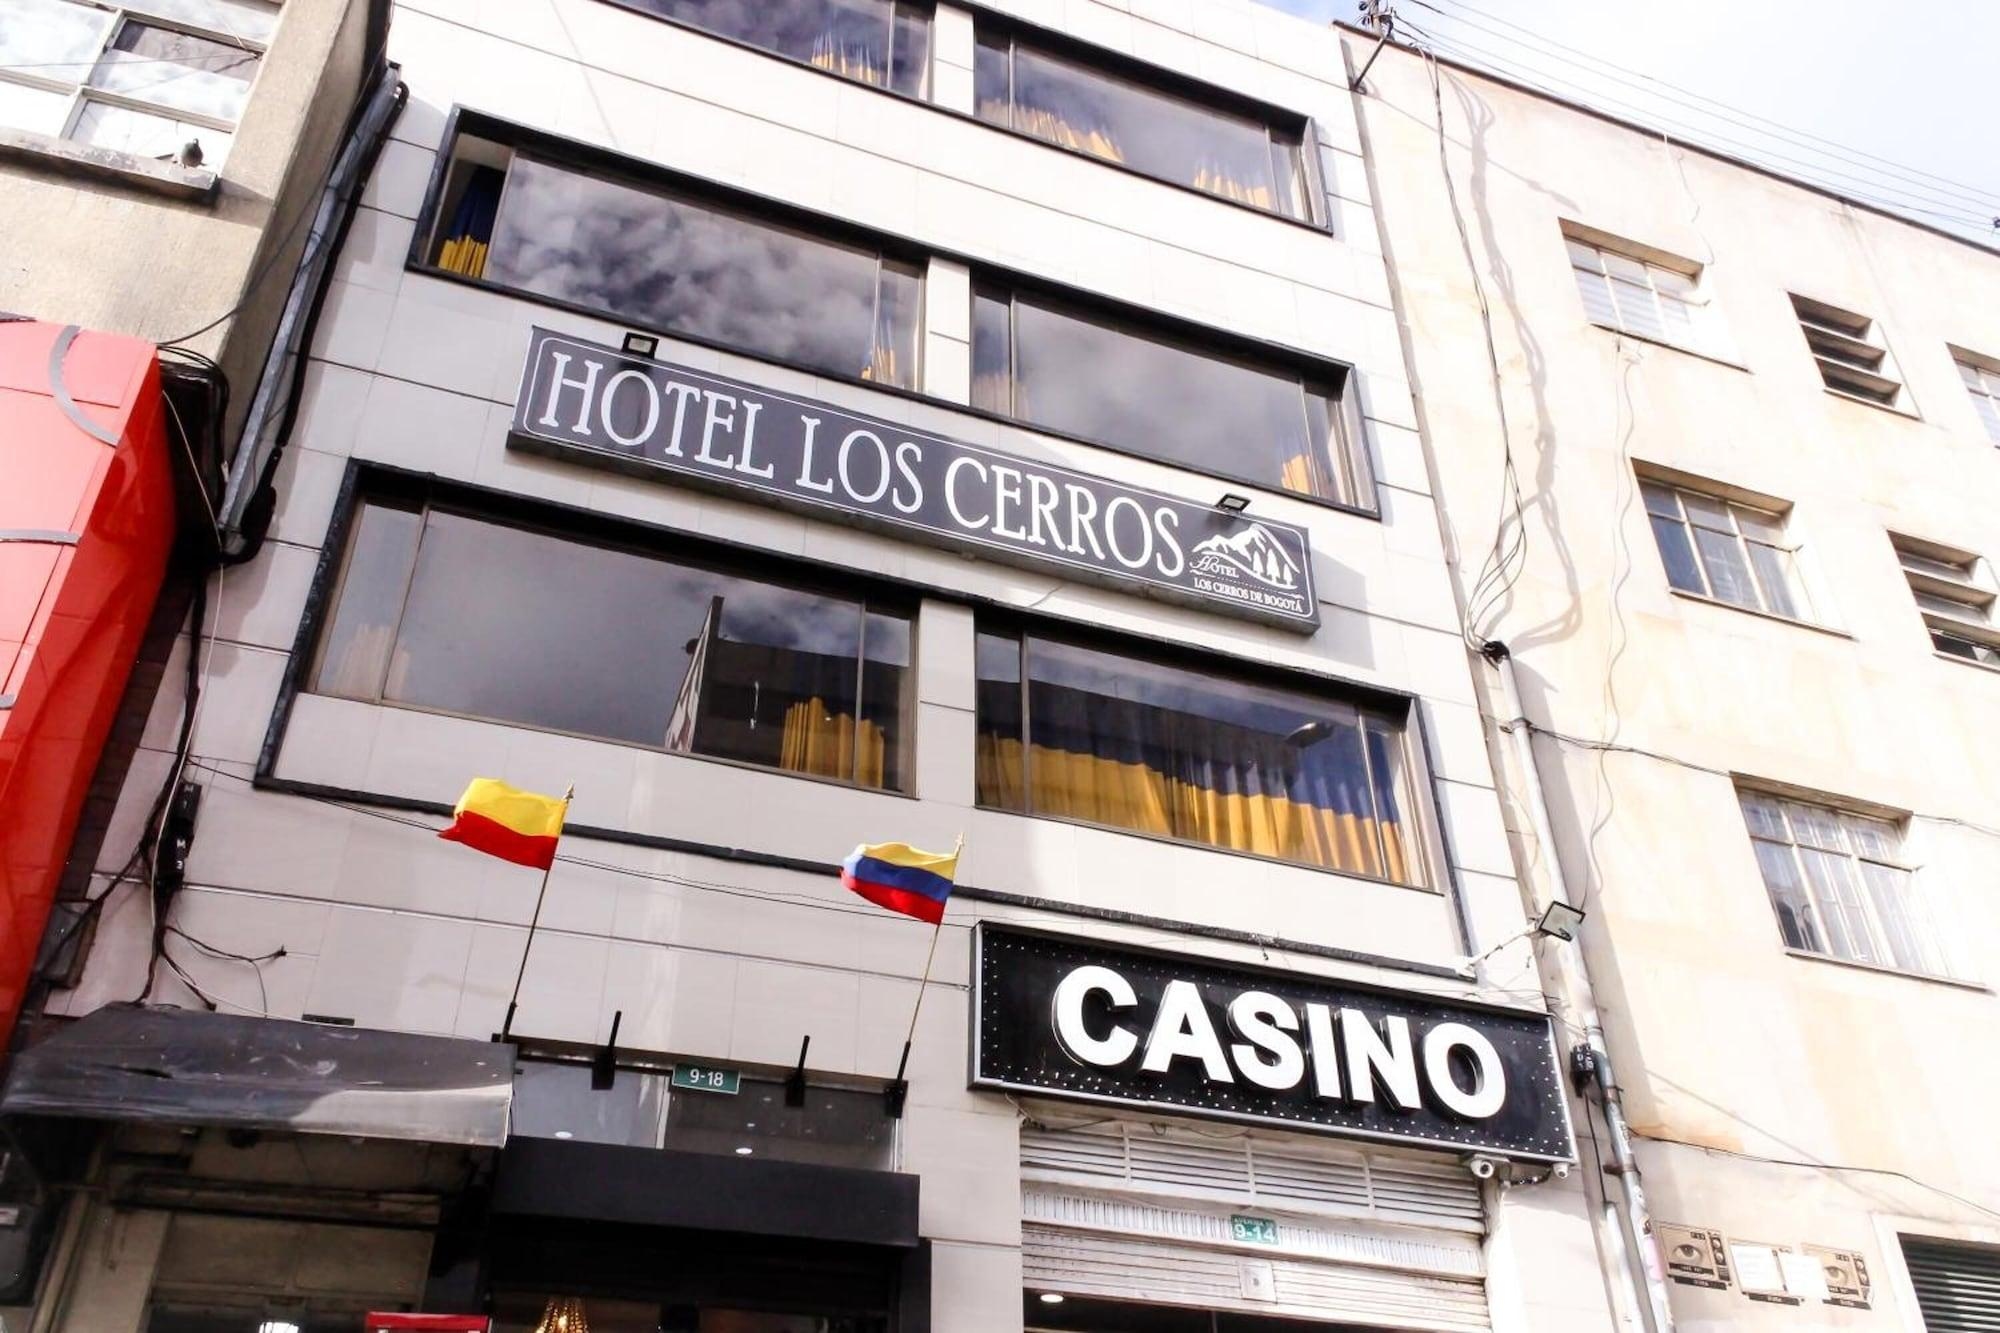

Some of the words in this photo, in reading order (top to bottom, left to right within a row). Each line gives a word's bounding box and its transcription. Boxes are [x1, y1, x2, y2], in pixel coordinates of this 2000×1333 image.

[539, 351, 775, 480] HOTEL
[796, 415, 923, 514] LOS
[945, 456, 1185, 577] CERROS
[1189, 556, 1240, 577] HOTEL
[1193, 577, 1212, 592] LOS
[1213, 581, 1249, 599] CERROS
[1249, 590, 1264, 602] DE
[1052, 965, 1506, 1119] CASINO
[689, 1068, 724, 1087] 9-18
[1234, 1223, 1275, 1243] 9-14
